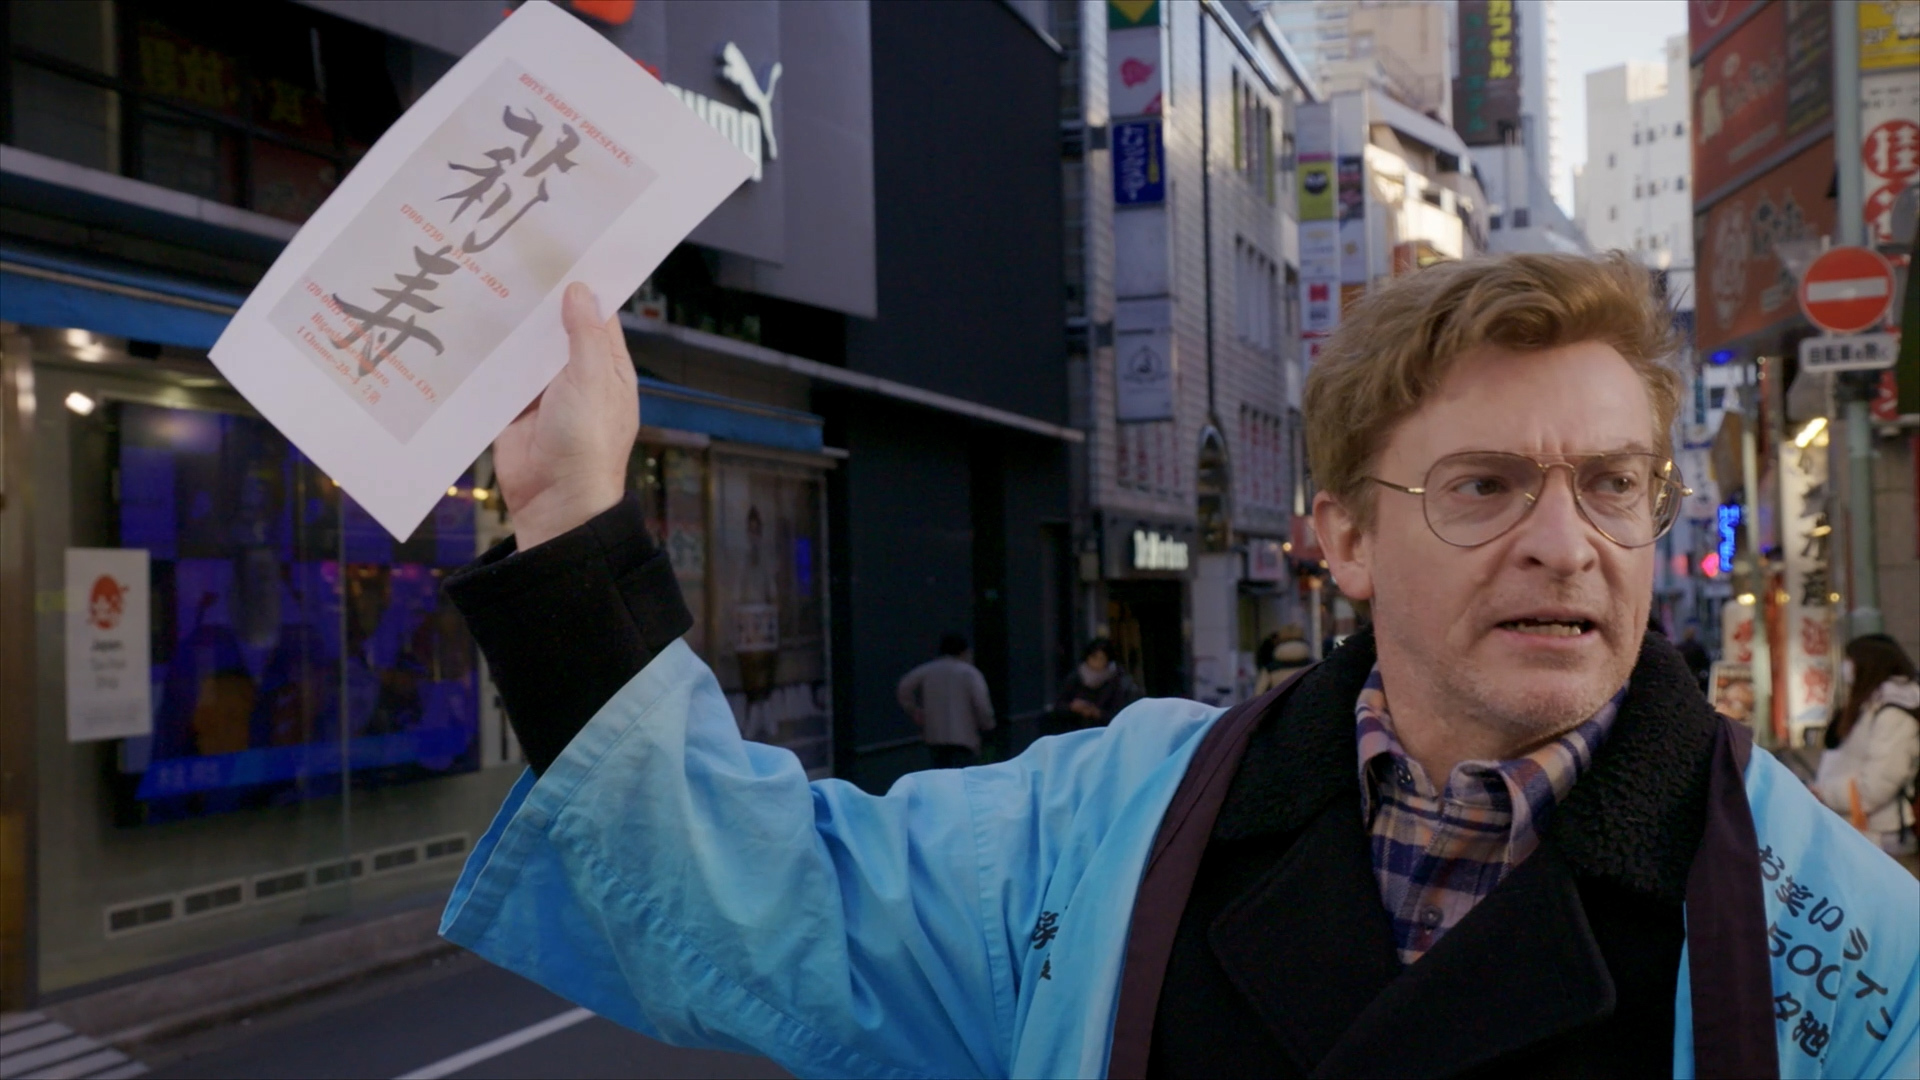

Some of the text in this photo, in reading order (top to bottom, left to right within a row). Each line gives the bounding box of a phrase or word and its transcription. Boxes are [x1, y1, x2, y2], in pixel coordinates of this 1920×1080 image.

[518, 72, 545, 95] RHYS
[543, 92, 580, 123] DARBY
[664, 82, 763, 181] UMA
